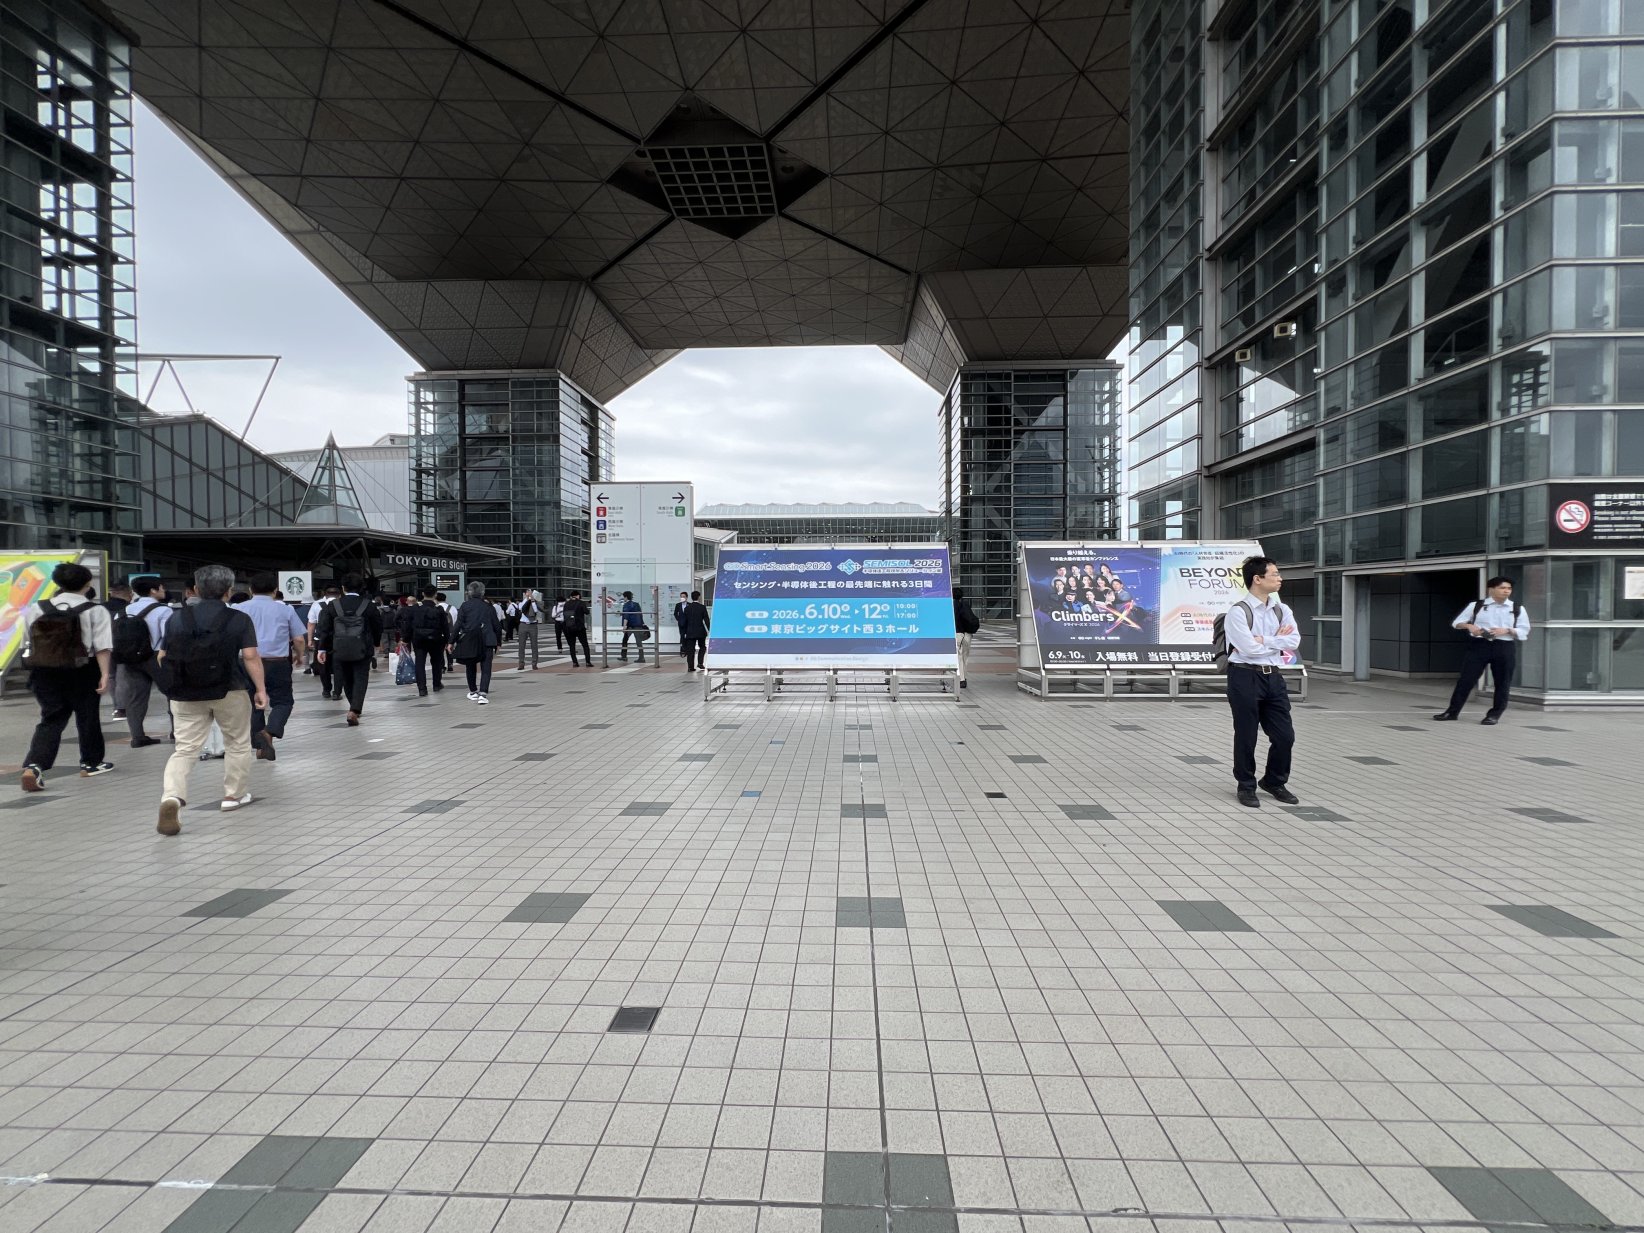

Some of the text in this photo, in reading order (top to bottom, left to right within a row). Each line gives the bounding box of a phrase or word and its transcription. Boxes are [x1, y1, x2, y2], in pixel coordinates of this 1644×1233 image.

[386, 554, 468, 570] TOKYO BIG SIGHT
[863, 560, 942, 568] SEMISOL 2026
[740, 562, 832, 573] Smart Sensing 2026
[734, 580, 933, 589] センシング・半導体後工程の最先端に触れる3日間
[1188, 579, 1245, 588] FORUM
[1052, 610, 1114, 622] Climbers
[770, 624, 919, 634] 東京ビッグサイト西3ホール
[1096, 652, 1138, 661] 入場無料
